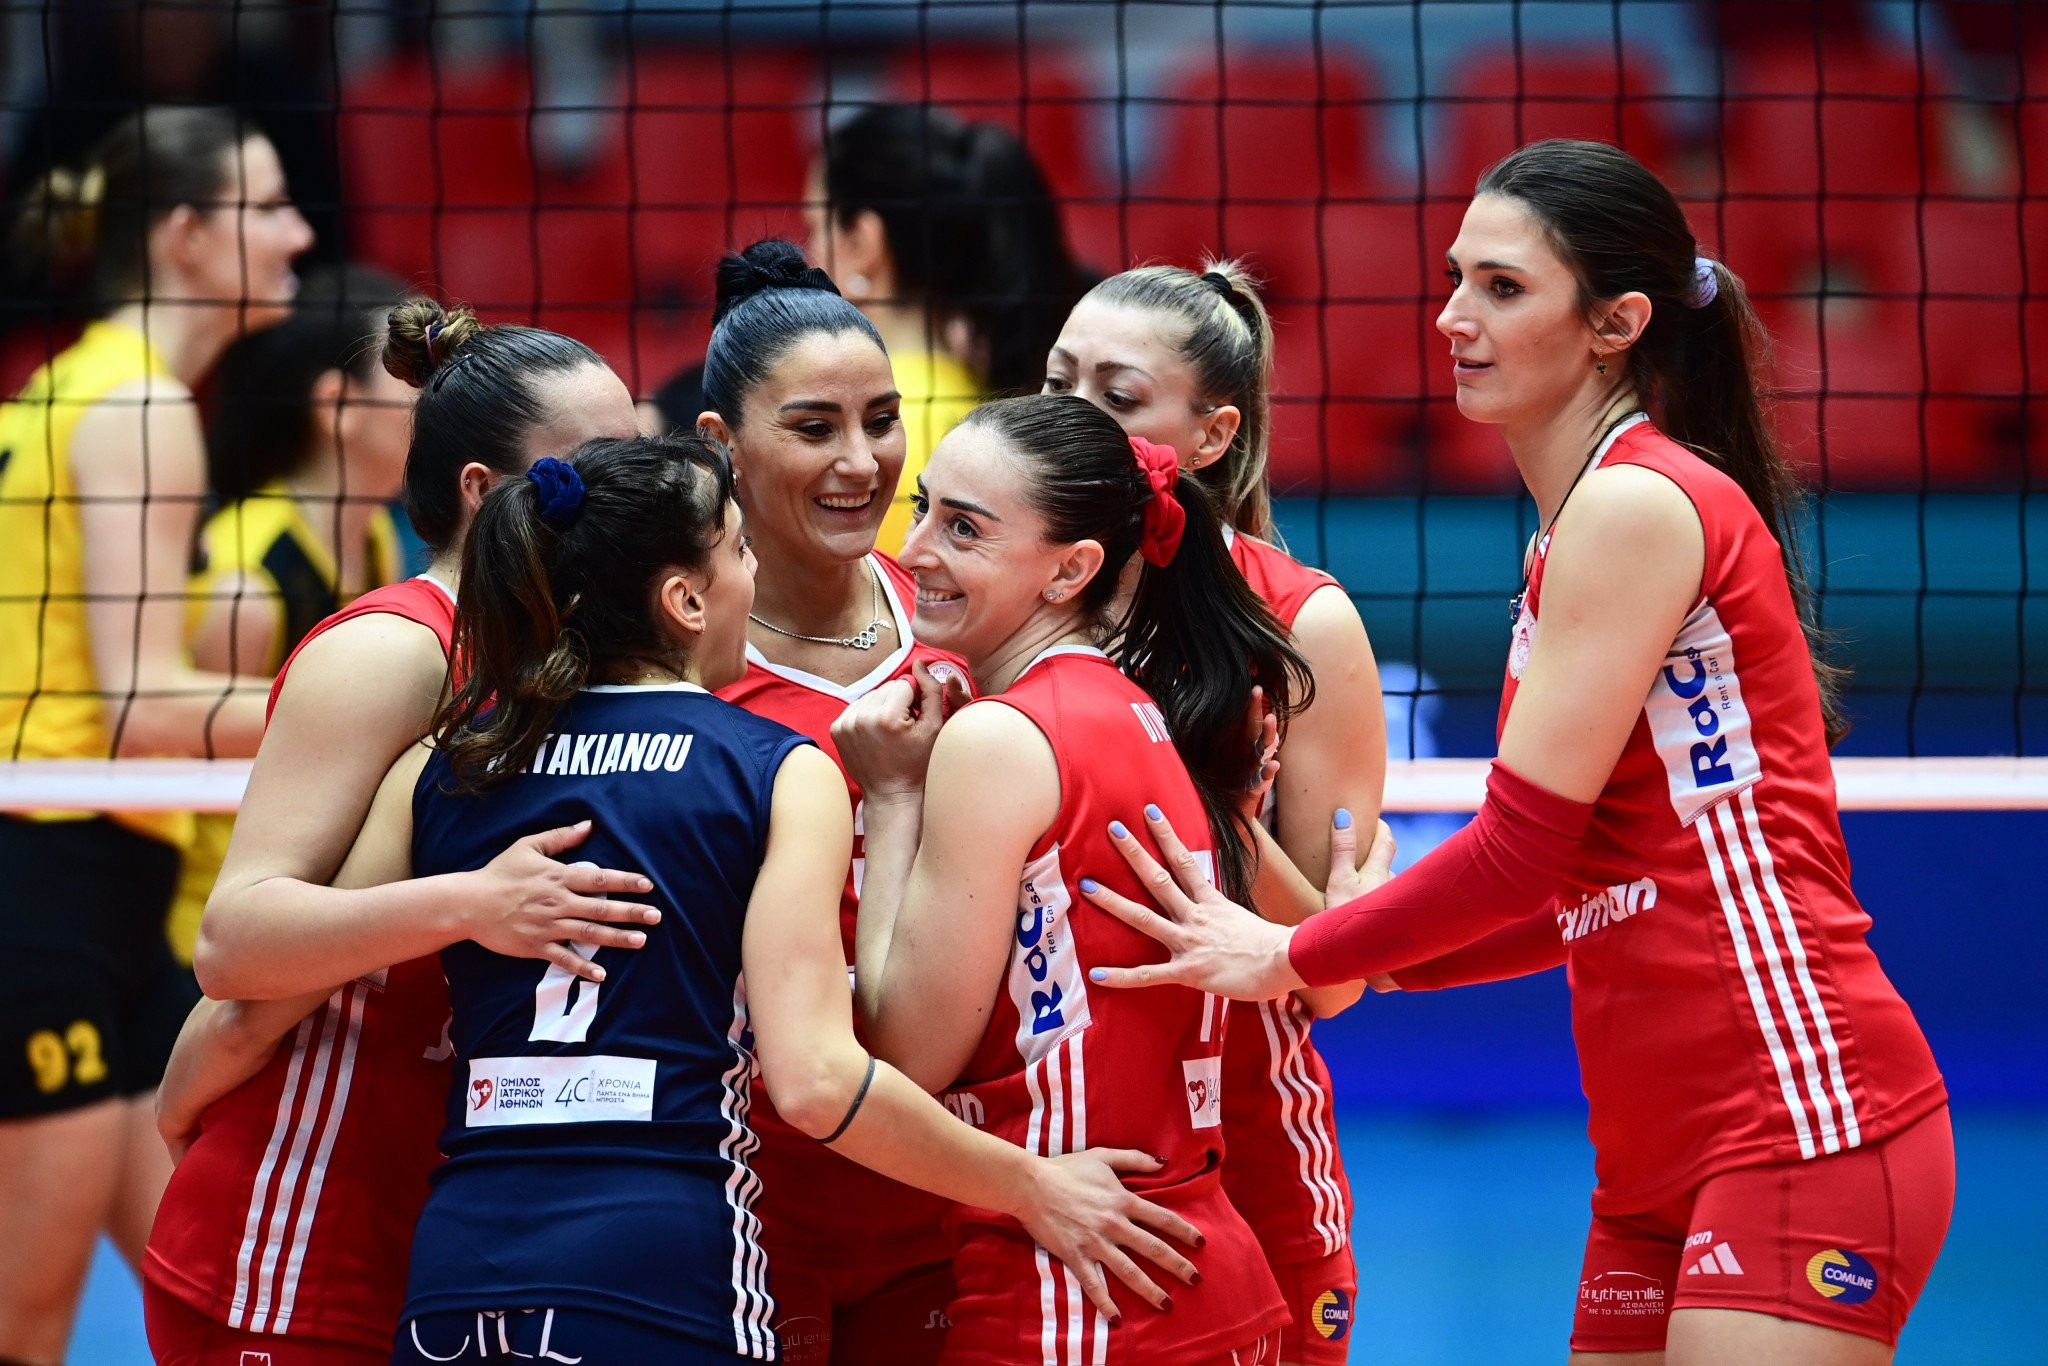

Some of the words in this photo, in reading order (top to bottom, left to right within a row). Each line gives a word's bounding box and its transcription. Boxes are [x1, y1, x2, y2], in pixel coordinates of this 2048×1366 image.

[1708, 657, 1719, 673] Car
[1718, 684, 1731, 710] Rent
[1663, 658, 1735, 788] RaC
[485, 732, 694, 776] TAKIANOU
[1046, 904, 1055, 924] Car
[1556, 876, 1658, 945] ximan
[1046, 931, 1058, 954] Ren
[1016, 906, 1065, 1035] RaC
[26, 1020, 107, 1094] 92
[500, 1077, 541, 1087] ΟΜΙΛΟΣ
[597, 1078, 641, 1089] ΧΡΟΝΙΑ
[499, 1088, 545, 1098] ΙΑΤΡΙΚΟΥ
[498, 1099, 543, 1109] ΑΘΗΝΩΝ
[1824, 1267, 1874, 1290] COMLINE
[1323, 1308, 1349, 1321] COMLINE
[1613, 1308, 1665, 1316] ΧΙΛΙΟΜΕΤΡΟ
